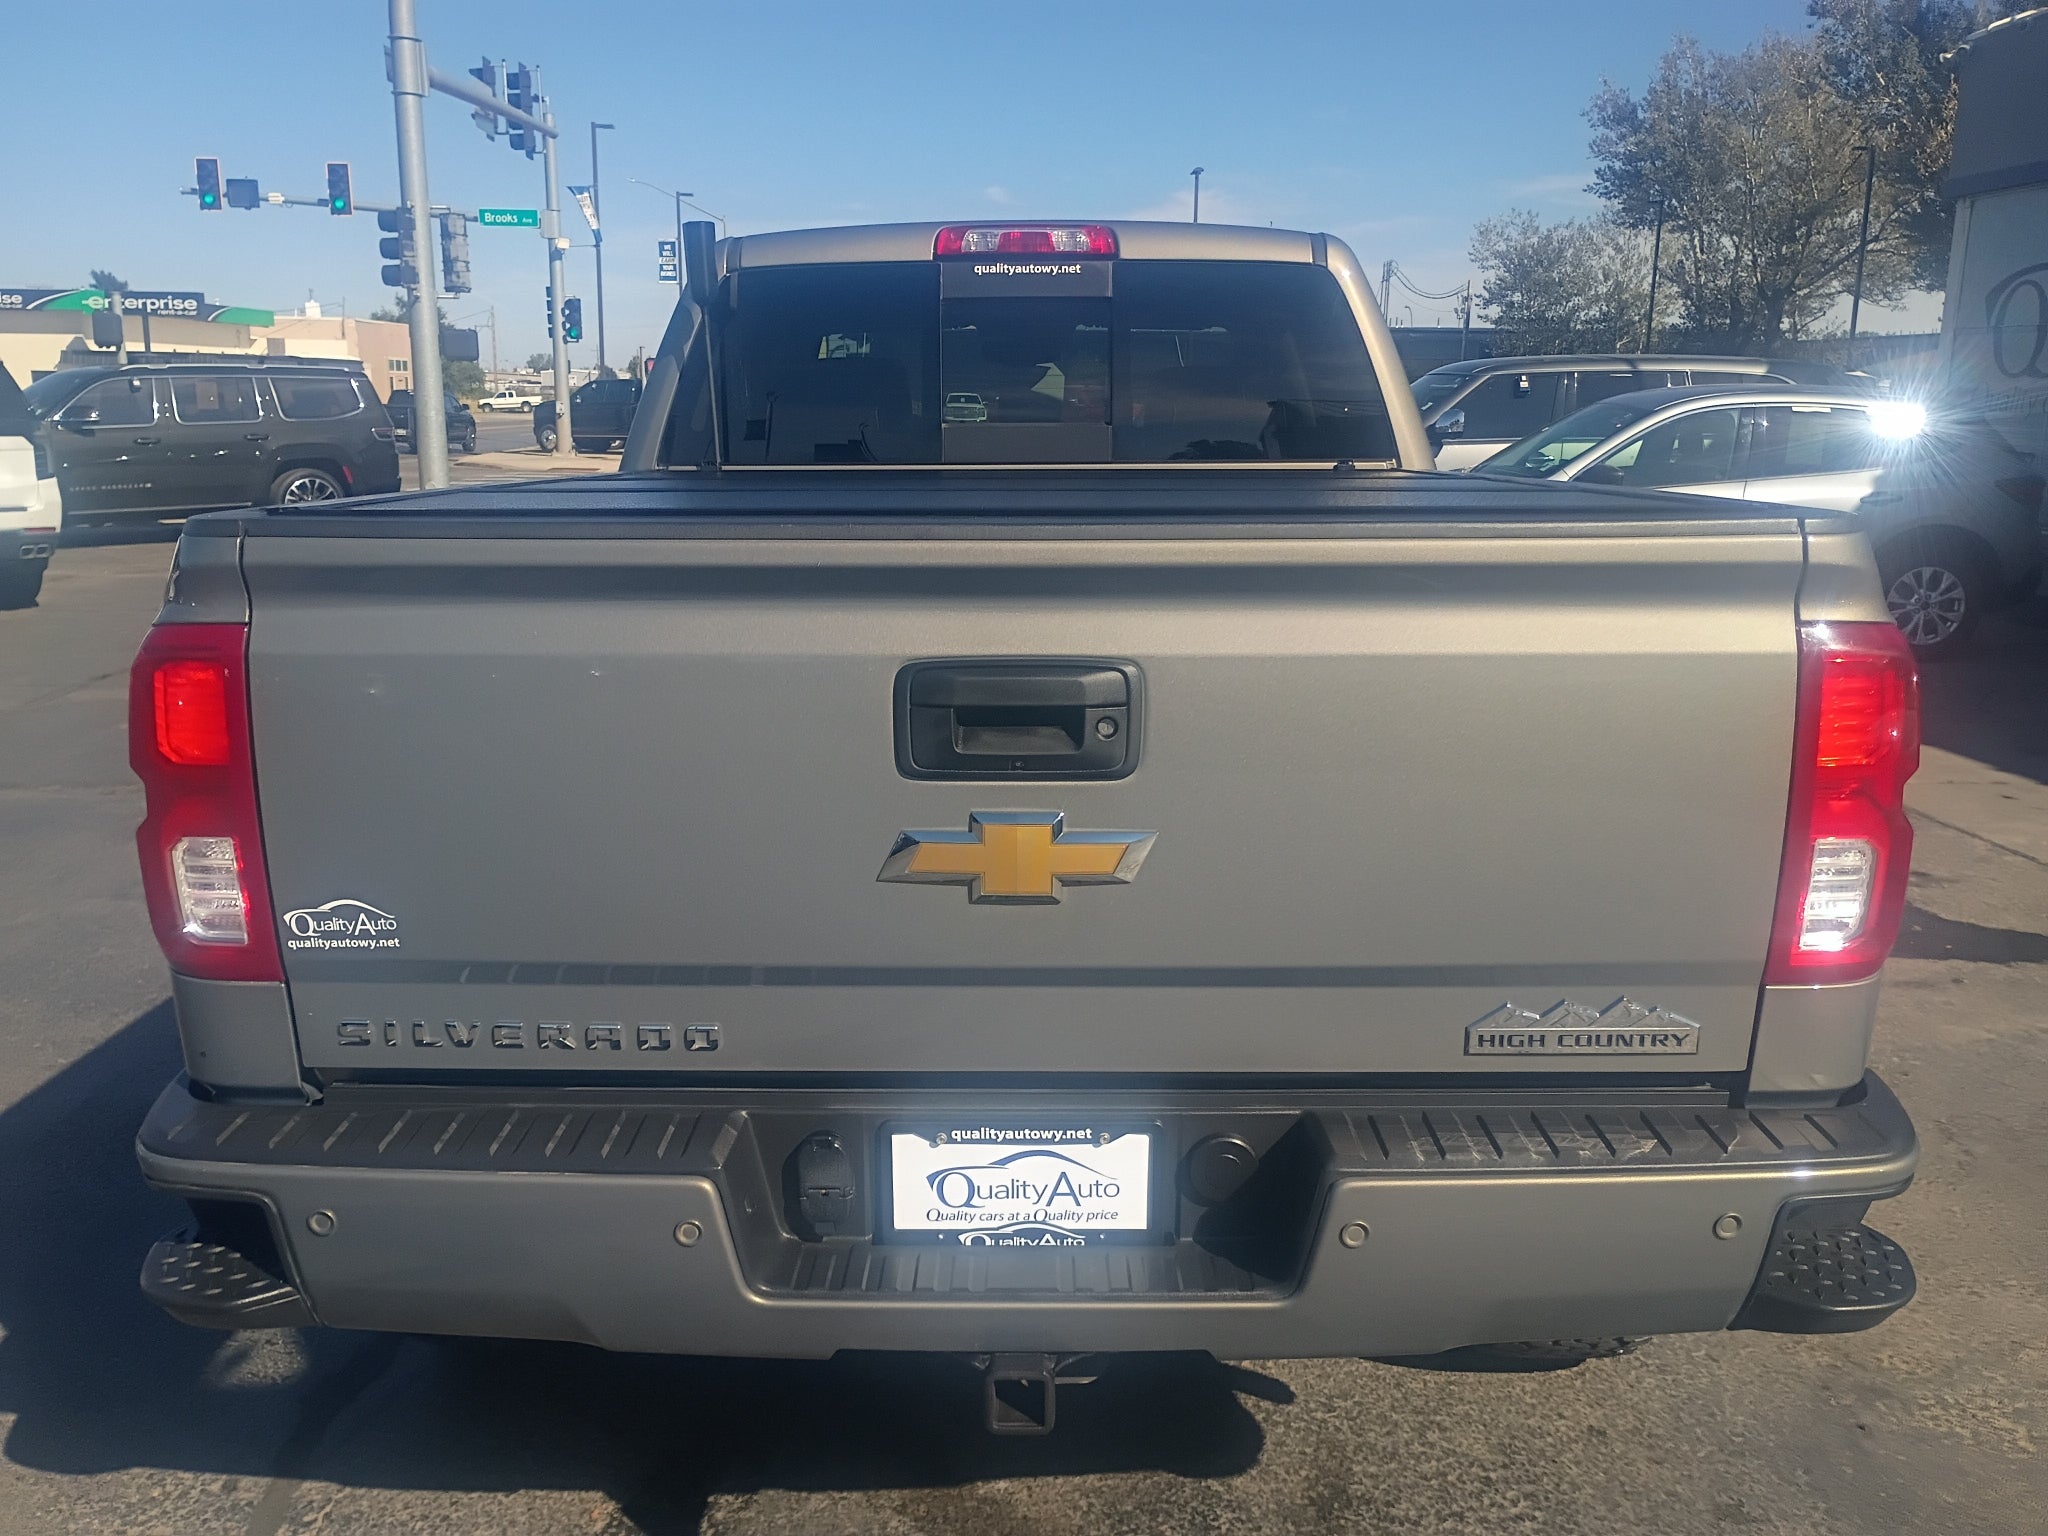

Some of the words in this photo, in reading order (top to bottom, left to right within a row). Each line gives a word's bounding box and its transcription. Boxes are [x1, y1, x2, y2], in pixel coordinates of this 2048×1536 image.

[484, 212, 518, 223] Brooks
[974, 262, 1081, 276] qualityautowy.net
[83, 295, 198, 313] enerprise
[287, 937, 401, 950] qualityautowy.net
[337, 1019, 723, 1052] SILVERADO
[1477, 1033, 1546, 1048] HIGH
[1557, 1032, 1690, 1048] COUNTRY
[951, 1127, 1092, 1142] qualityautowy.net
[926, 1208, 976, 1223] Quality
[979, 1212, 1004, 1221] cars
[1007, 1211, 1020, 1221] at
[1023, 1213, 1030, 1221] a
[1033, 1208, 1083, 1223] Quality
[1086, 1209, 1119, 1222] price
